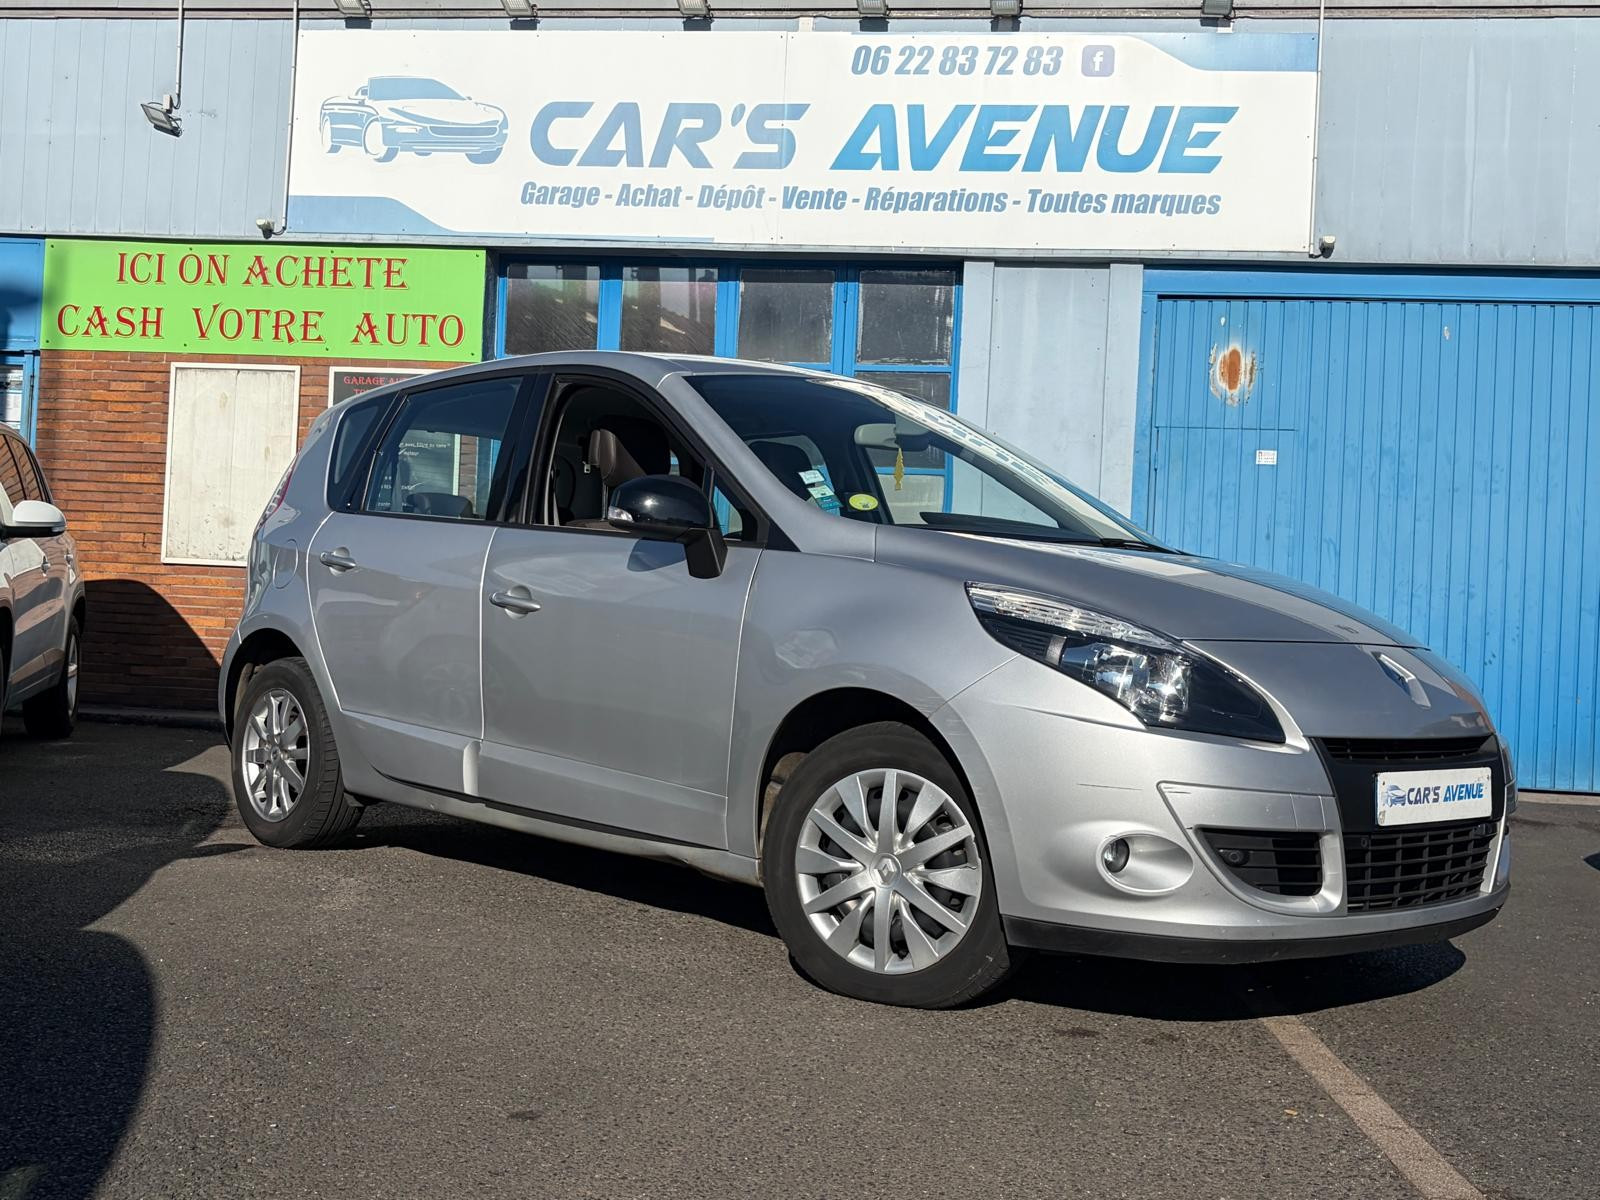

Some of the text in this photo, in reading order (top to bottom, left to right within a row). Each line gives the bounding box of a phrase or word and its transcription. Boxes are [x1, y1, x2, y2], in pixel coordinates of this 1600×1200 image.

[851, 45, 1063, 75] 06 22 83 72 83
[530, 101, 1240, 173] CAR'S AVENUE
[521, 182, 600, 208] Garage
[615, 183, 682, 207] Achat
[697, 184, 765, 210] Dépôt
[782, 186, 847, 210] Vente
[864, 186, 1007, 213] Réparations
[1027, 188, 1107, 213] Toutes
[1111, 193, 1221, 215] marques
[117, 252, 408, 289] ICI ON ACHETE
[57, 303, 465, 347] CASH VOTRE AUTO
[343, 376, 385, 386] GARAGE
[1407, 782, 1484, 805] CAR'S AVENUE
